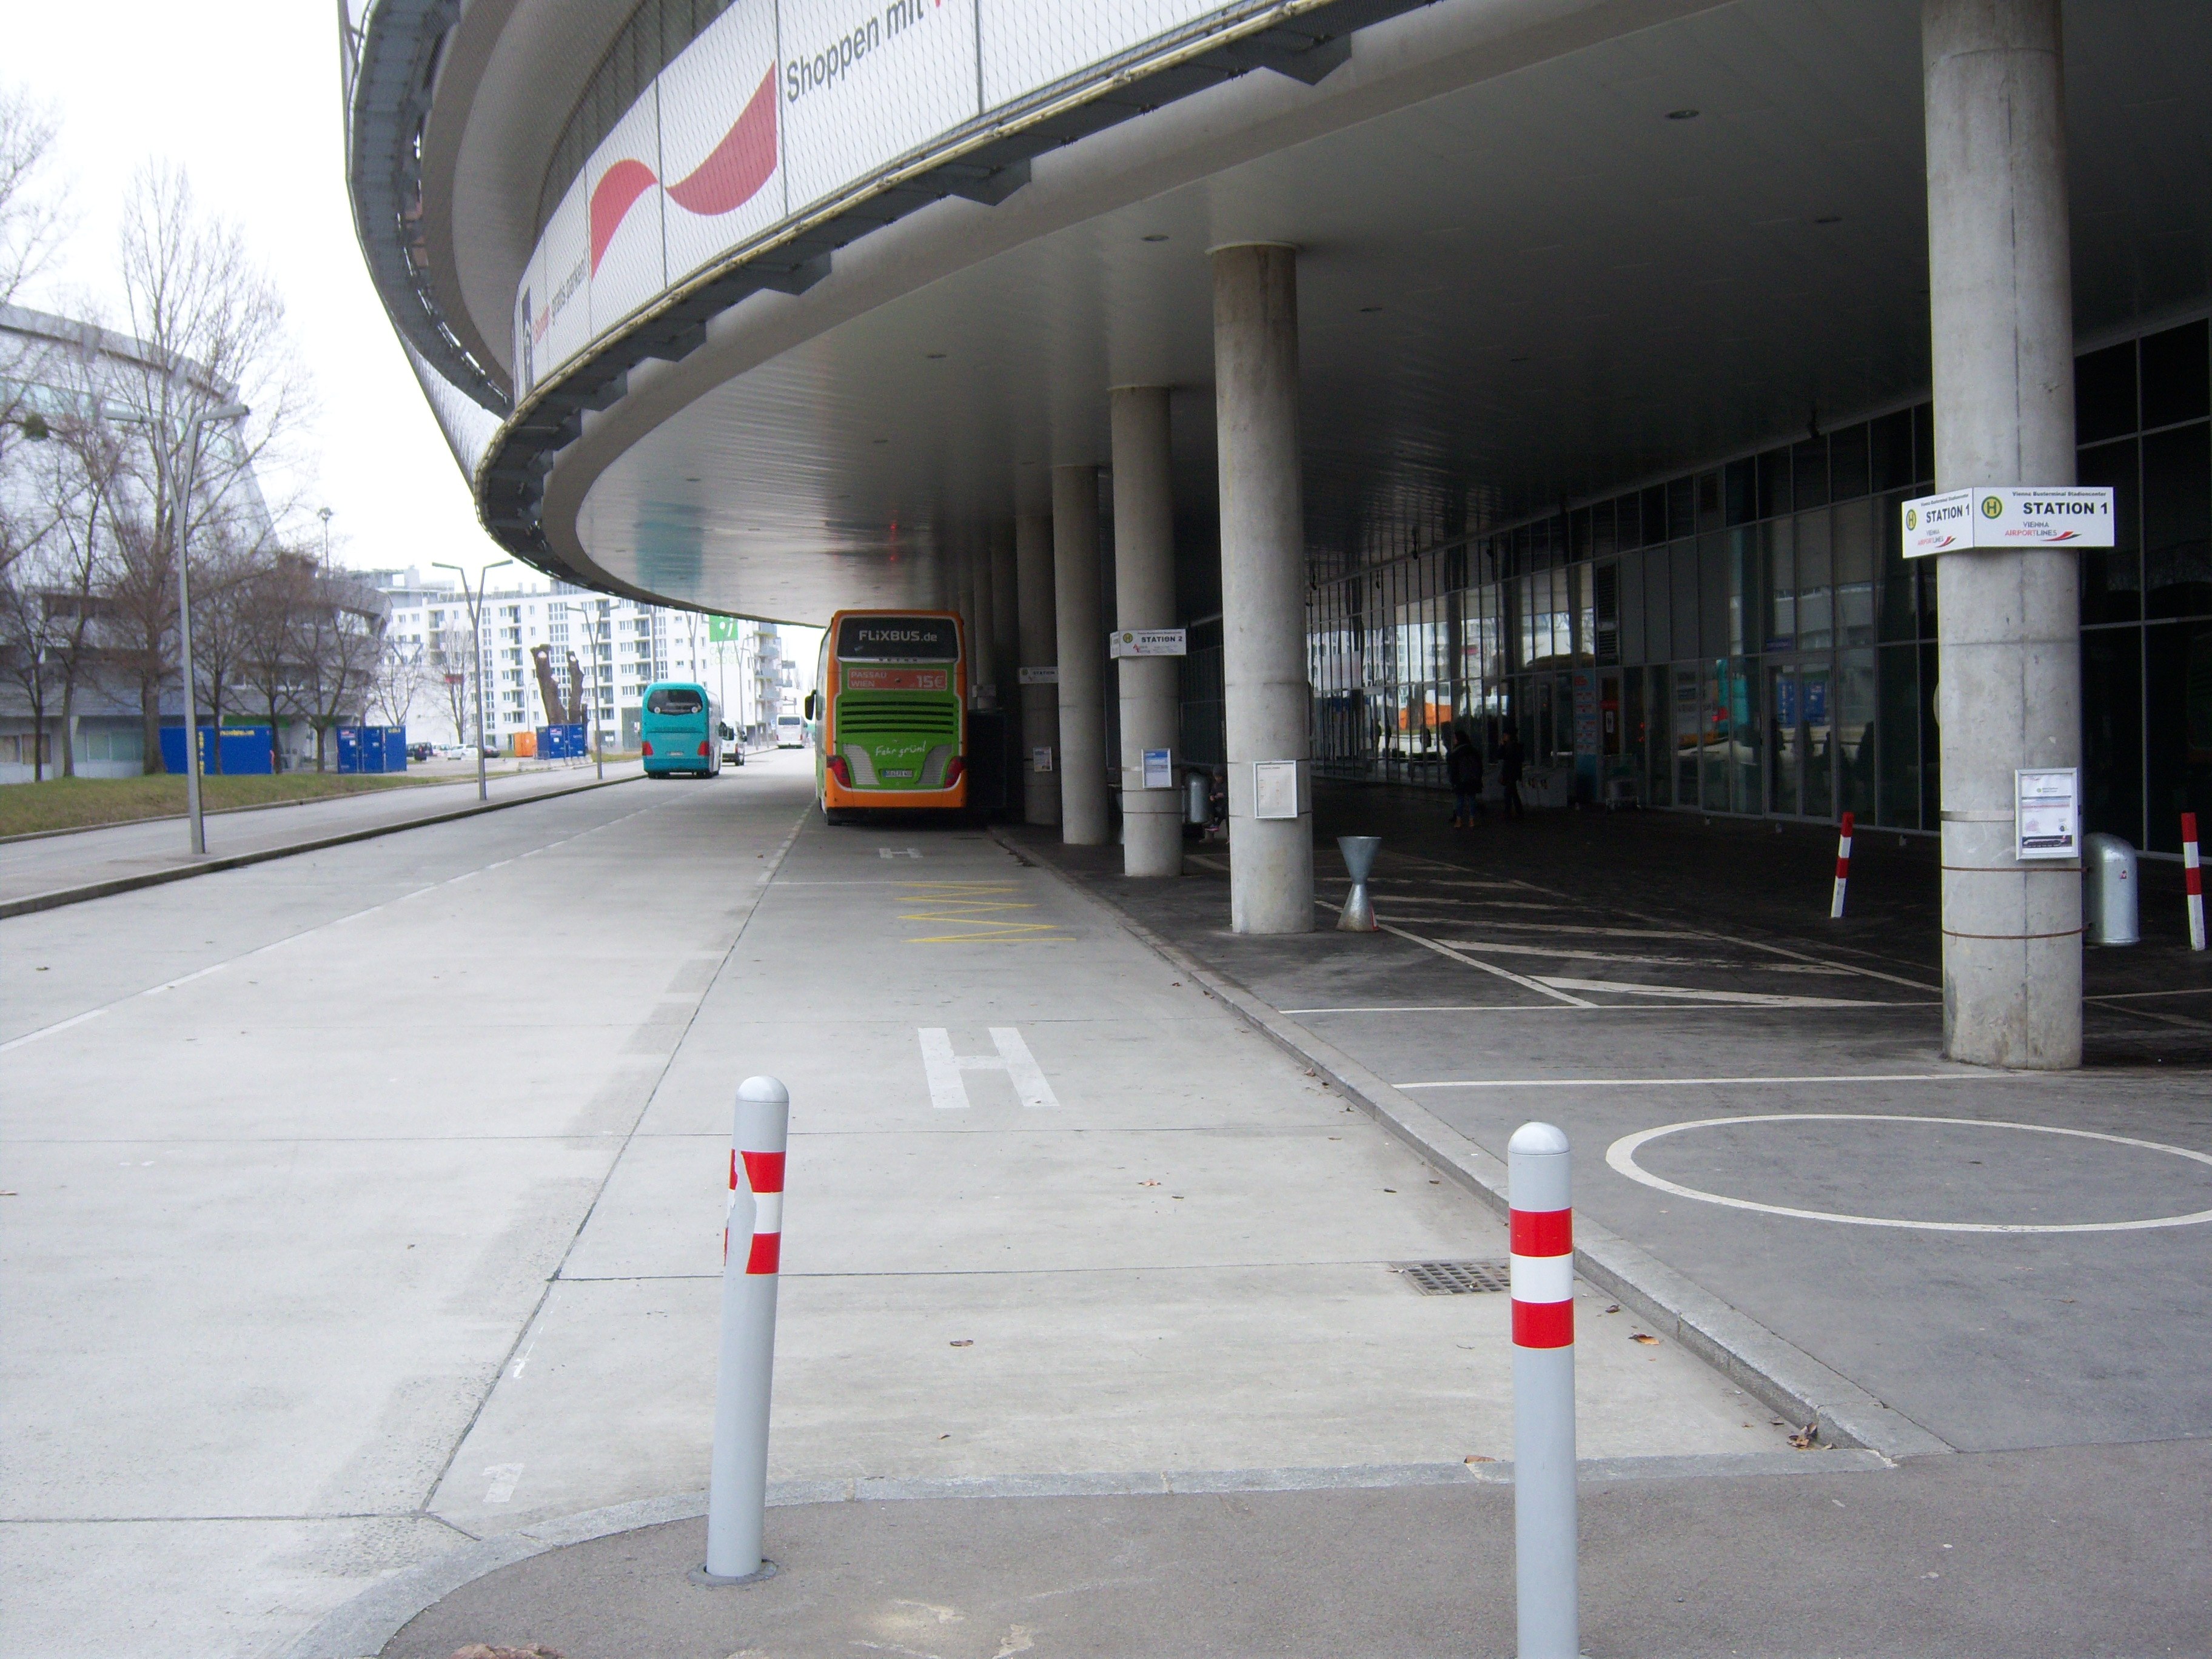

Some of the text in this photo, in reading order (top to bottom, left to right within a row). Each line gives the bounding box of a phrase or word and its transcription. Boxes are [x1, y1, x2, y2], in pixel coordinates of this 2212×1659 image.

[786, 0, 924, 103] Shoppen mit
[1926, 503, 1970, 523] STATION 1
[2023, 502, 2108, 515] STATION 1
[916, 675, 944, 688] 15€
